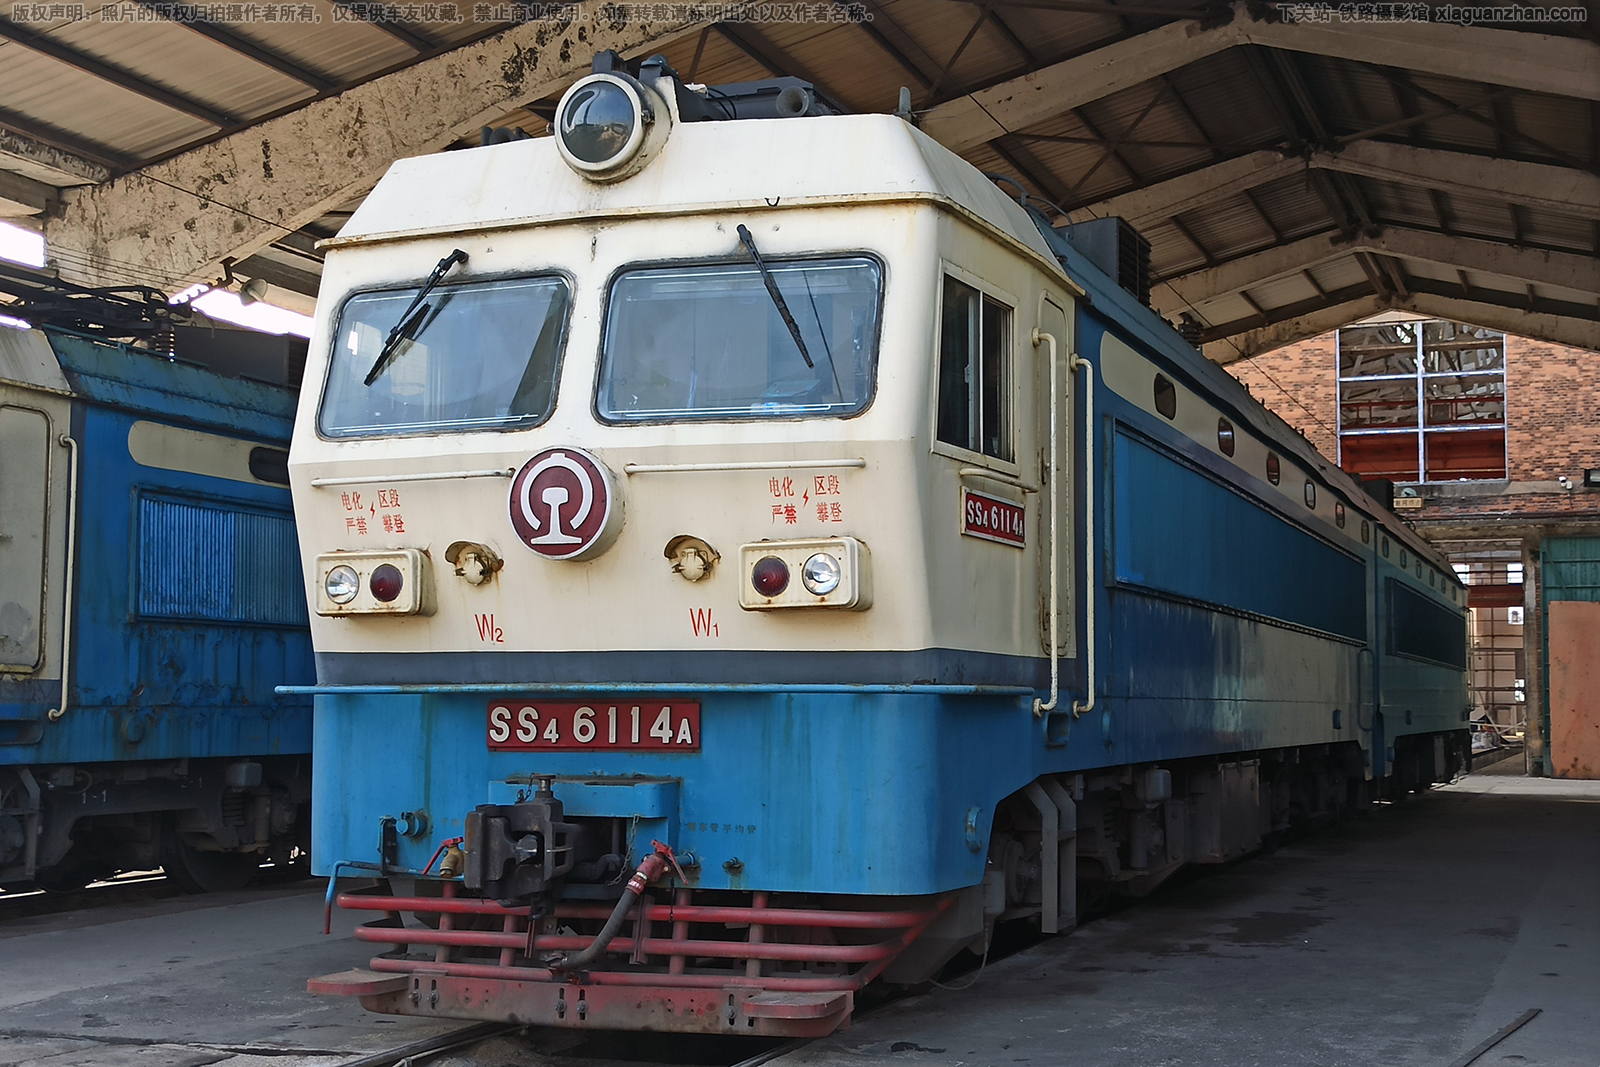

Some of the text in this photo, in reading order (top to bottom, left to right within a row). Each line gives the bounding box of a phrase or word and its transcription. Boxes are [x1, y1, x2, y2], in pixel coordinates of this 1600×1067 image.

[769, 474, 840, 497] 电化 区段
[341, 489, 401, 511] 电化 区段
[771, 502, 842, 525] 严禁 攀登
[345, 516, 367, 536] 严禁
[474, 614, 504, 643] W2
[689, 608, 719, 637] W1
[489, 706, 693, 744] SS4 6114A
